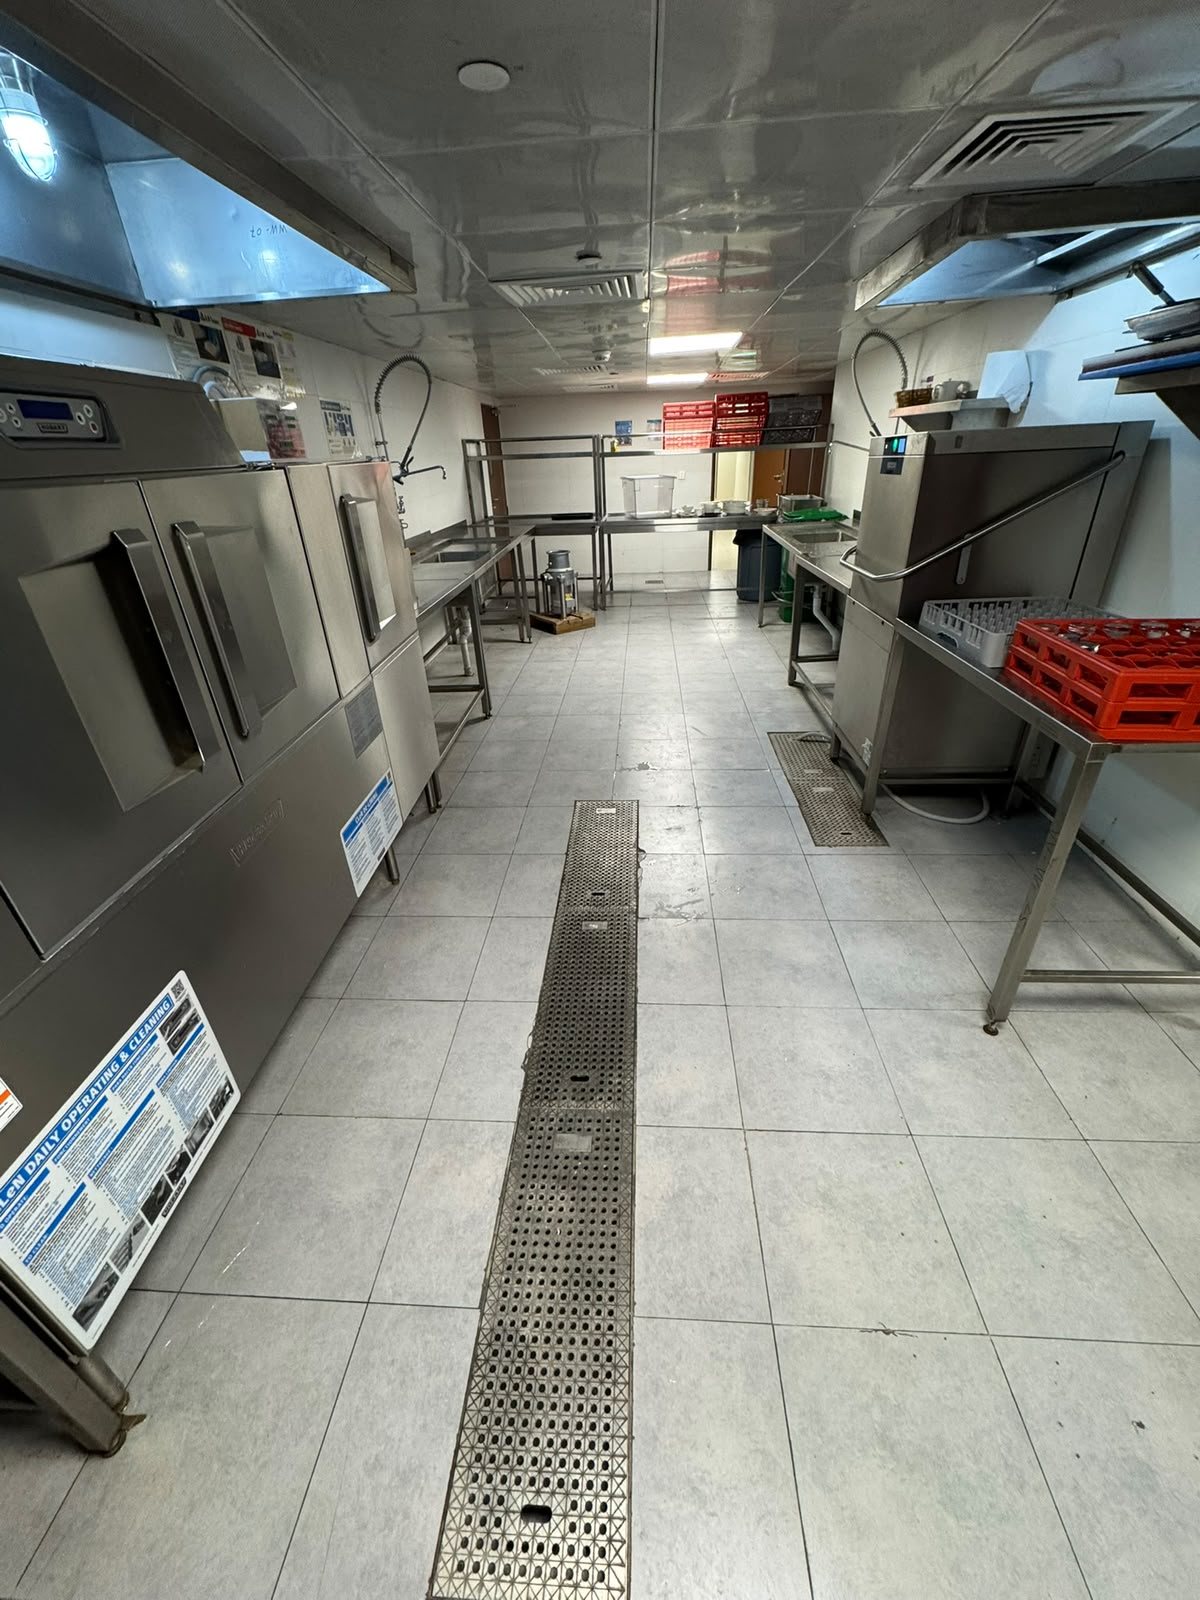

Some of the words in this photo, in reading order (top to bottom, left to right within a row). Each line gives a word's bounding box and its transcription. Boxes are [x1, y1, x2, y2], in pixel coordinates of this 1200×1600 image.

[0, 1175, 25, 1212] LeN
[25, 1131, 61, 1174] DAILY
[61, 1061, 119, 1130] OPERATING
[119, 1049, 129, 1063] &
[128, 1000, 170, 1052] CLEANING
